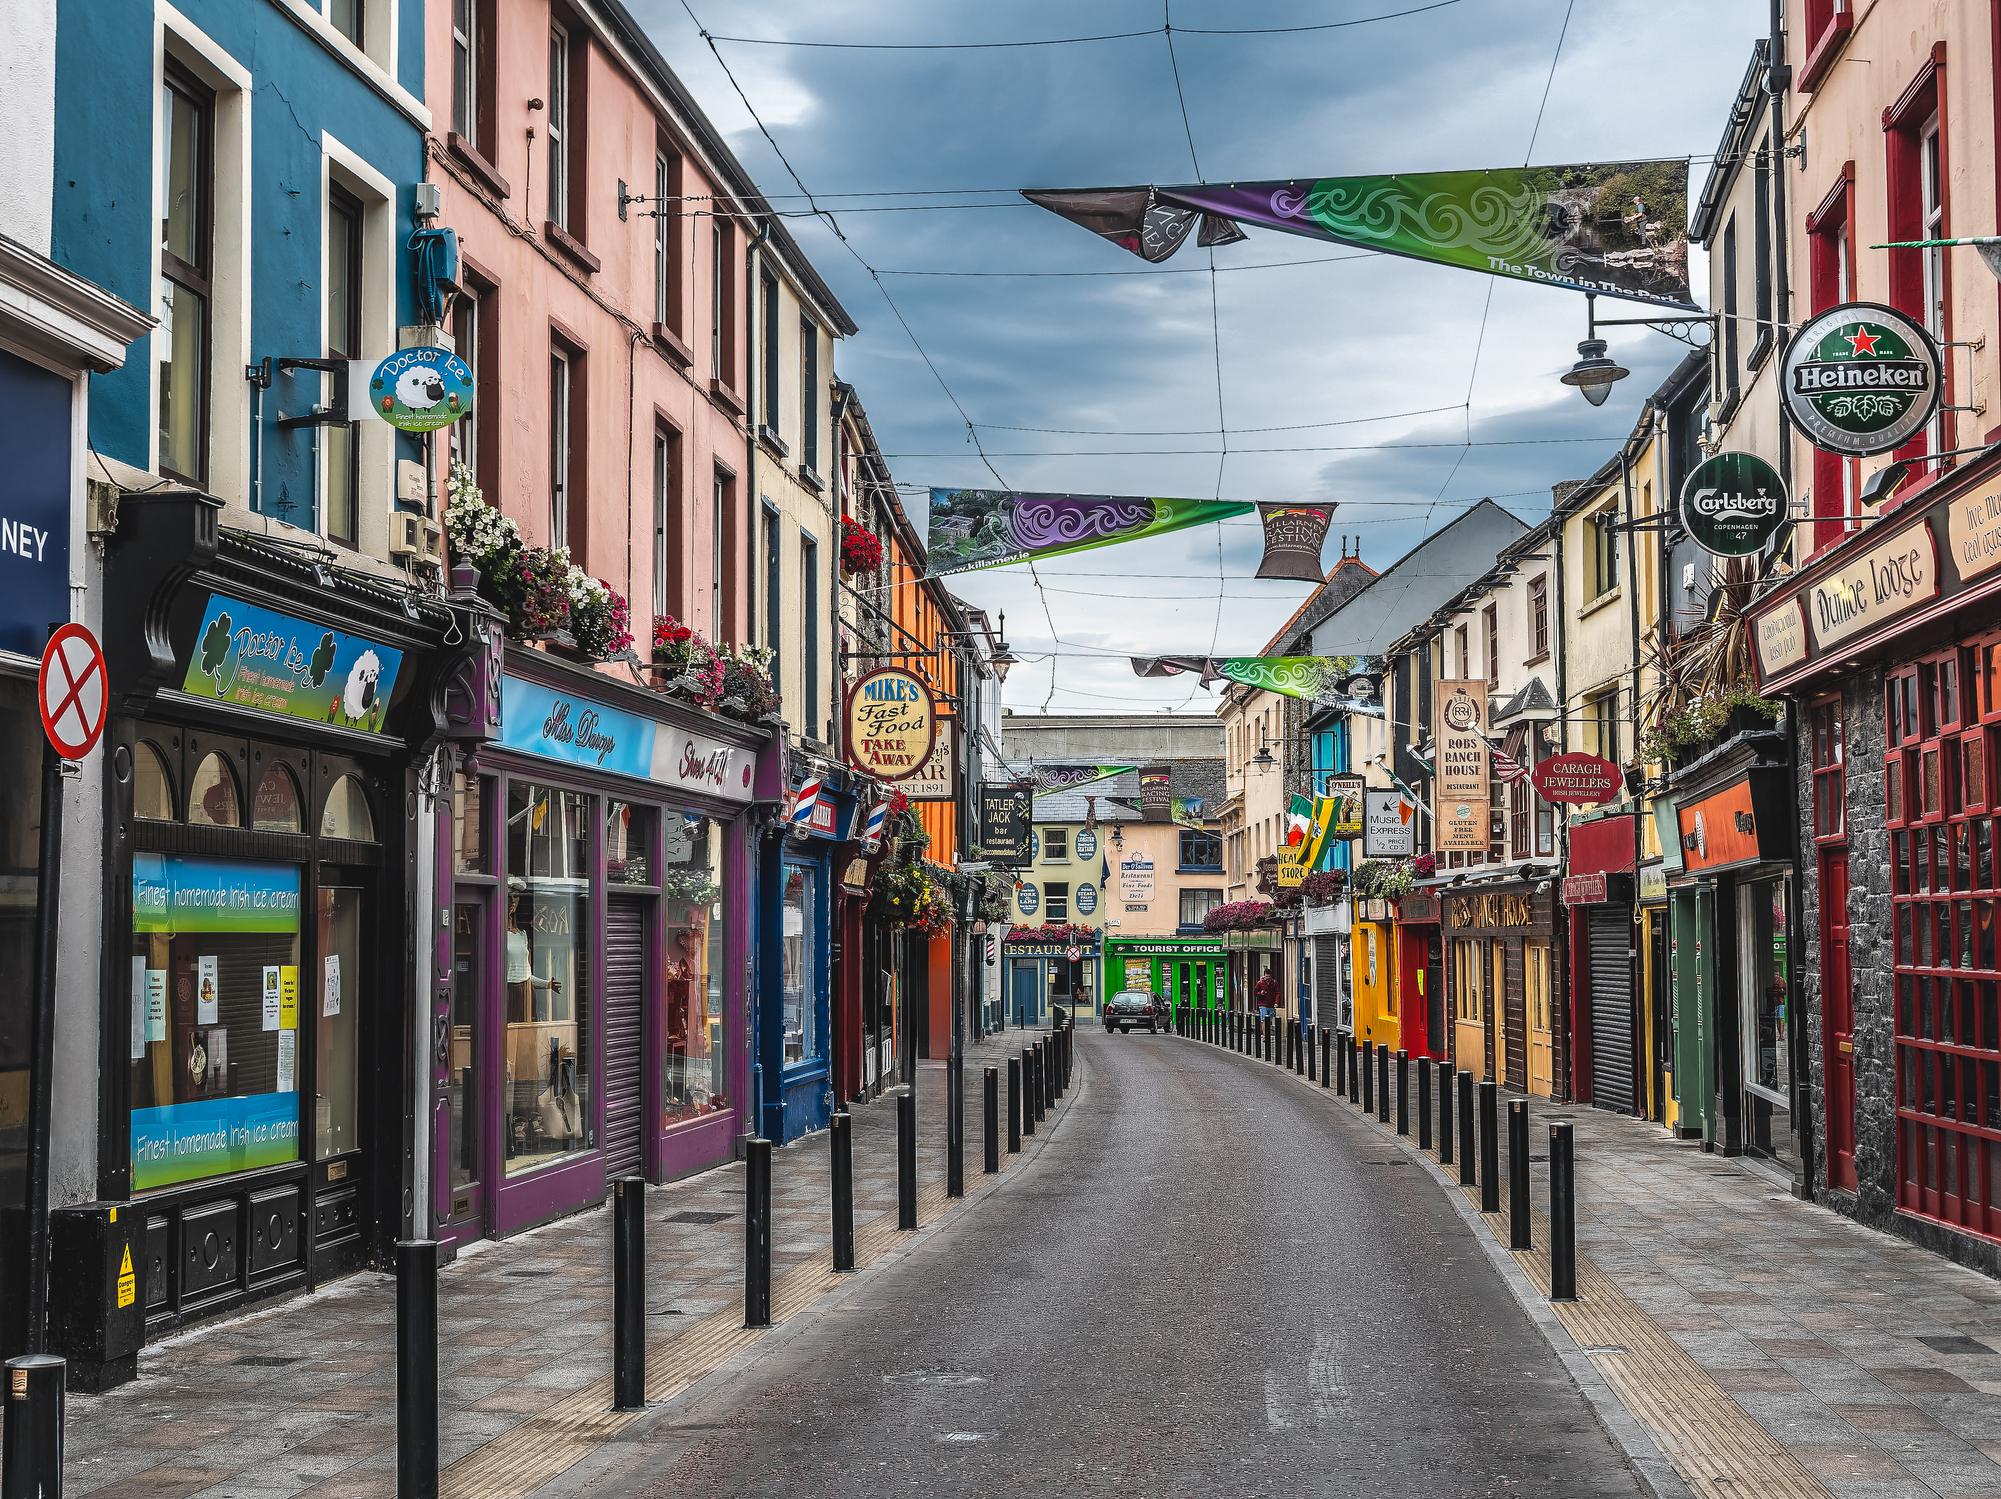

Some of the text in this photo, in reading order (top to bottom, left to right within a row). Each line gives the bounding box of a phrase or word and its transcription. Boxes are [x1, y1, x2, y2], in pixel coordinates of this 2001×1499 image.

[1487, 256, 1522, 274] The
[1524, 264, 1575, 284] Town
[1578, 276, 1597, 289] in
[380, 349, 465, 381] Doctor Ice
[1800, 364, 1924, 390] Heineken
[1807, 413, 1917, 446] PREMIUM QUALITY
[1693, 488, 1778, 516] Carlsberg
[1265, 519, 1325, 534] KILLARNEY
[2, 517, 48, 562] NEY
[1725, 531, 1747, 540] 1847
[935, 551, 1030, 576] www.killarney.ie
[1816, 549, 1923, 634] Dunloe Lodge
[234, 626, 304, 675] Doctor Ice
[237, 665, 296, 693] Finest homemade
[864, 678, 919, 702] MIKE'S
[251, 687, 265, 704] ice
[263, 694, 288, 710] cream
[1299, 692, 1314, 701] The
[1314, 696, 1336, 707] Town
[1335, 702, 1344, 710] in
[857, 702, 909, 722] Fast
[866, 715, 924, 737] Food
[861, 739, 906, 754] TAKE
[1448, 738, 1477, 749] ROBS
[868, 751, 915, 766] AWAY
[1445, 752, 1481, 762] RANCH
[1445, 765, 1481, 775] HOUSE
[1552, 763, 1602, 775] CARAGH
[920, 783, 946, 794] 1891
[1331, 781, 1361, 789] O'NEILL'S
[1542, 776, 1611, 789] JEWELLERS
[985, 798, 1015, 811] TATLER
[988, 811, 1011, 823] JACK
[1370, 815, 1400, 824] MUSIC
[994, 826, 1008, 835] bar
[1370, 825, 1411, 835] EXPRESS
[986, 837, 1015, 845] restaurant
[1281, 867, 1306, 879] STORE
[137, 876, 299, 909] Finest homemade Irish ice cream
[1133, 945, 1221, 953] TOURIST OFFICE
[136, 1117, 299, 1163] Finest homemade Irish ice cream
